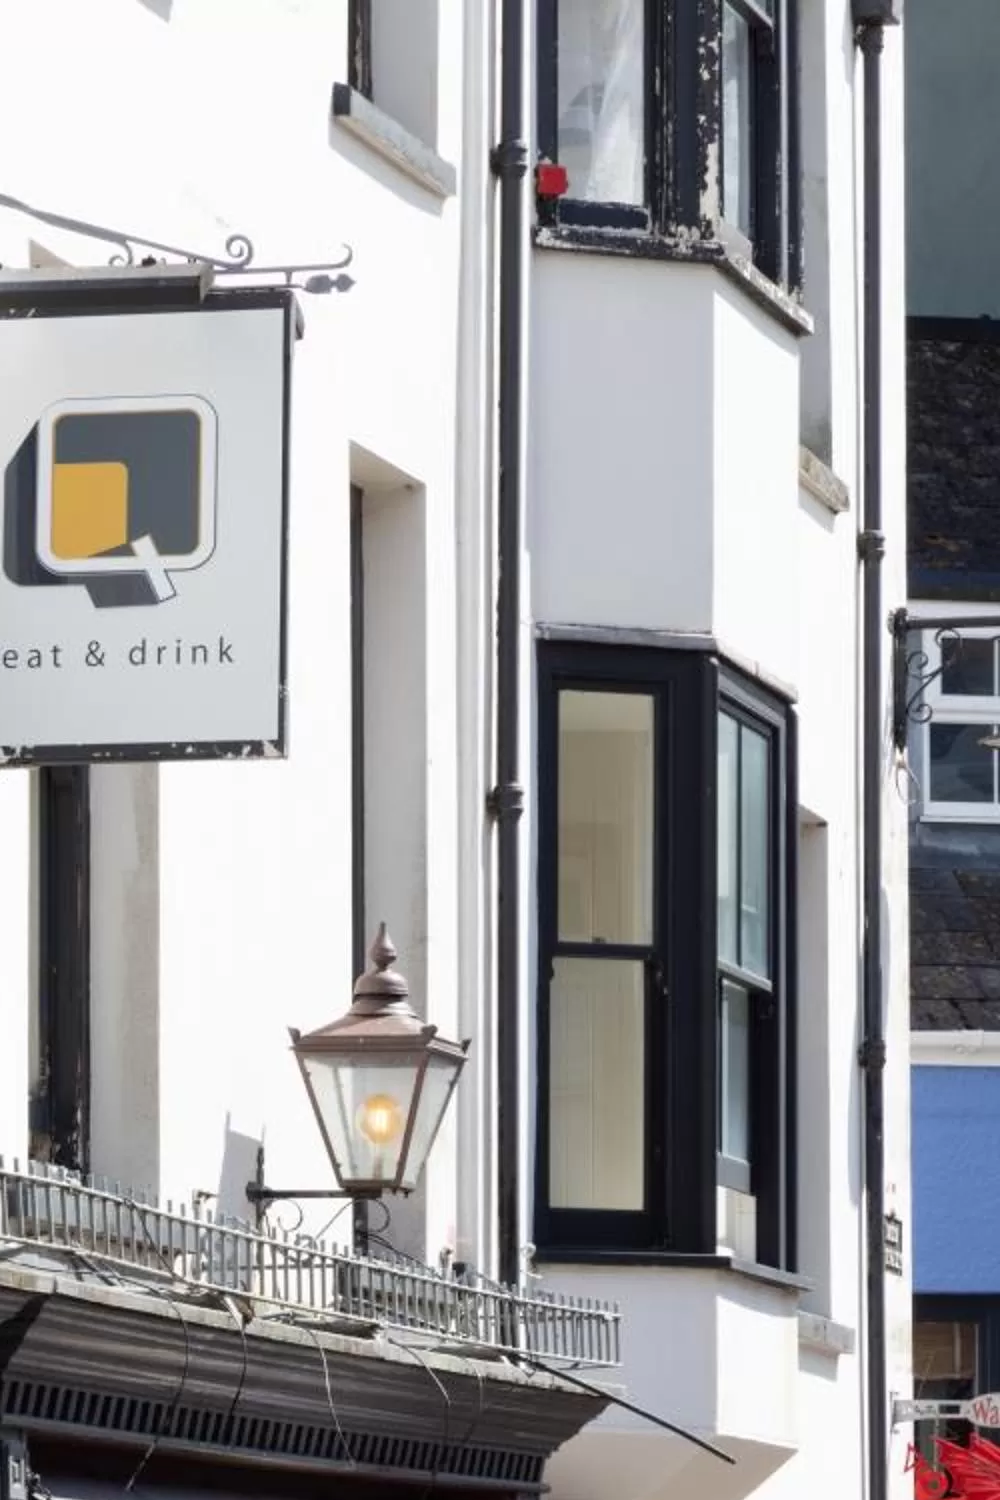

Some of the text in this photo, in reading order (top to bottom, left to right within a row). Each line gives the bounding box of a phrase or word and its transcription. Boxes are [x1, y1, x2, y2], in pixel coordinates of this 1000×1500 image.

[2, 635, 234, 669] eat & drink
